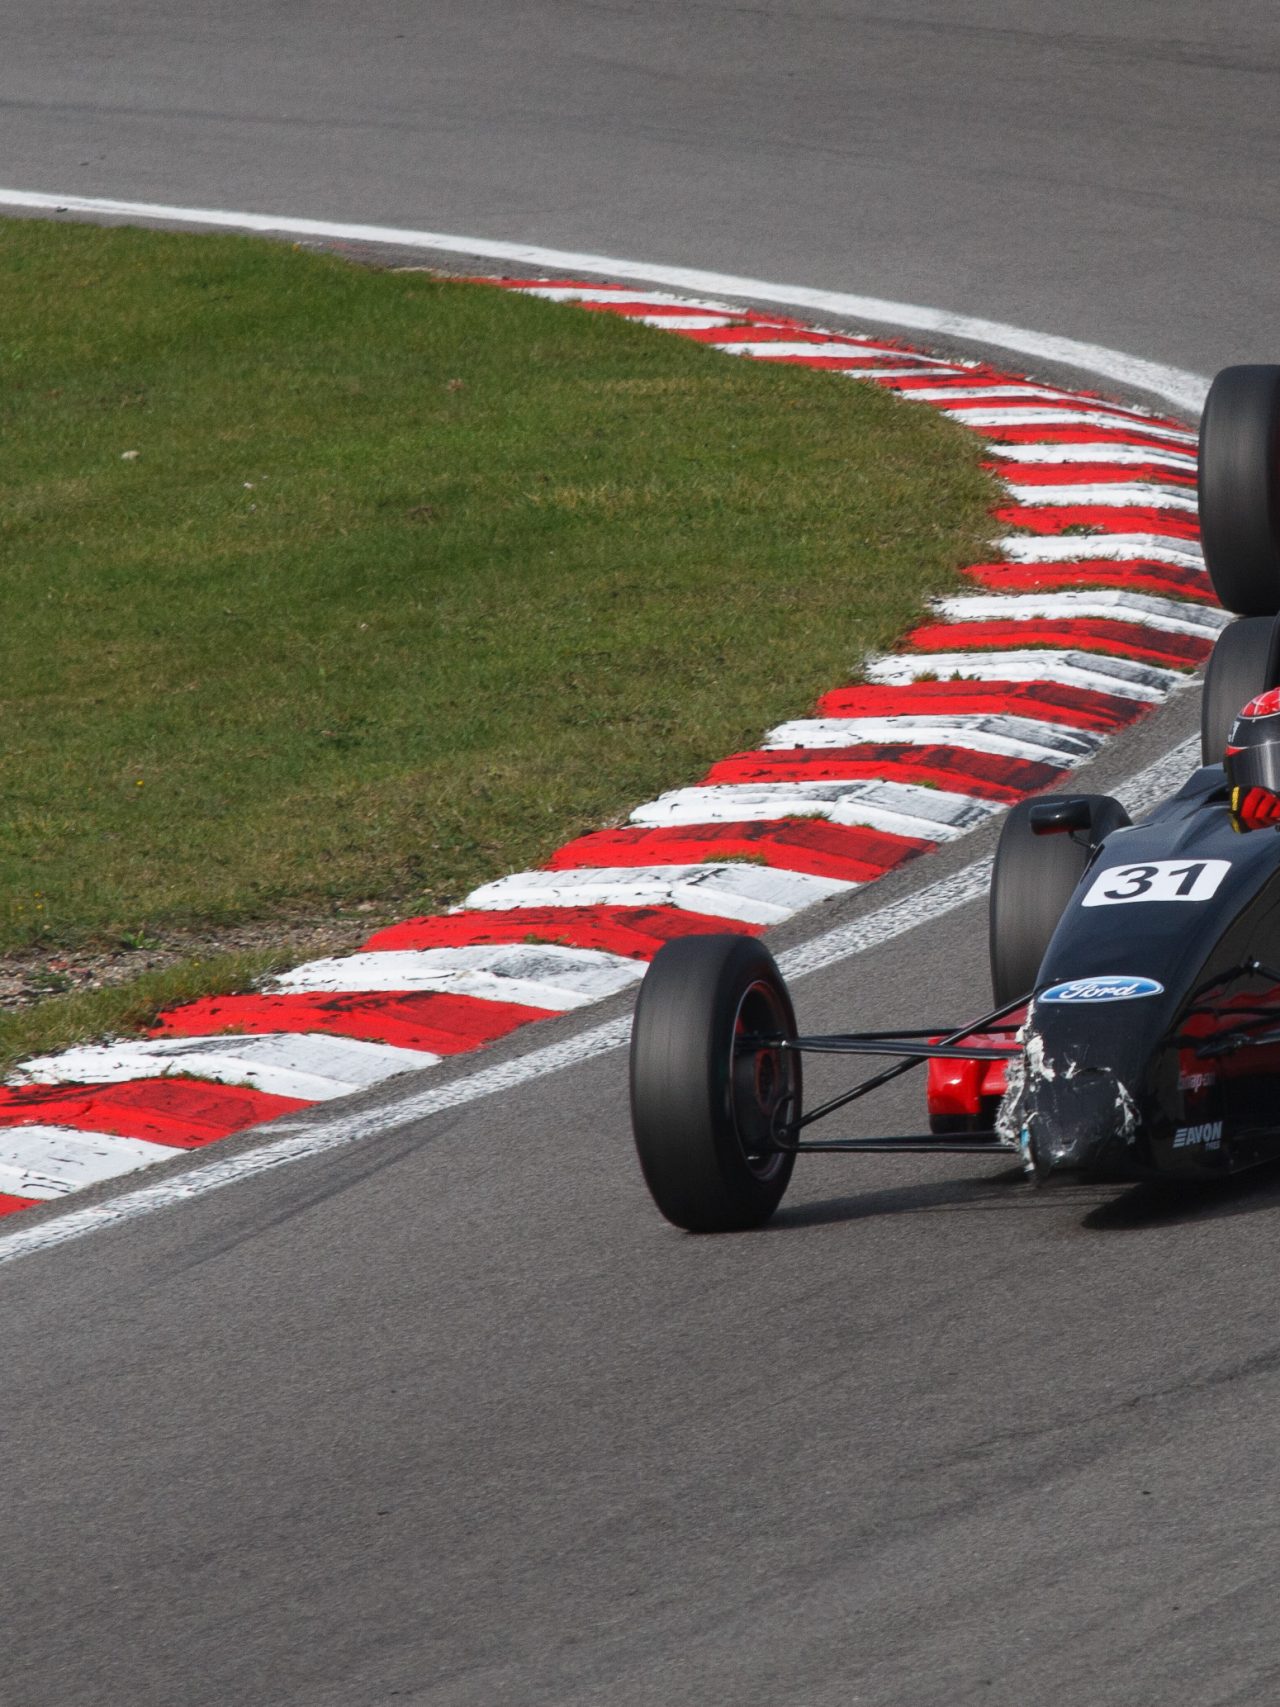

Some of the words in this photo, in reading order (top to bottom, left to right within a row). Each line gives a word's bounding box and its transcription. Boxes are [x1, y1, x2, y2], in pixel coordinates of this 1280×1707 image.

[1104, 863, 1208, 900] 31
[1059, 980, 1139, 998] Ford
[1185, 1121, 1223, 1146] AVON
